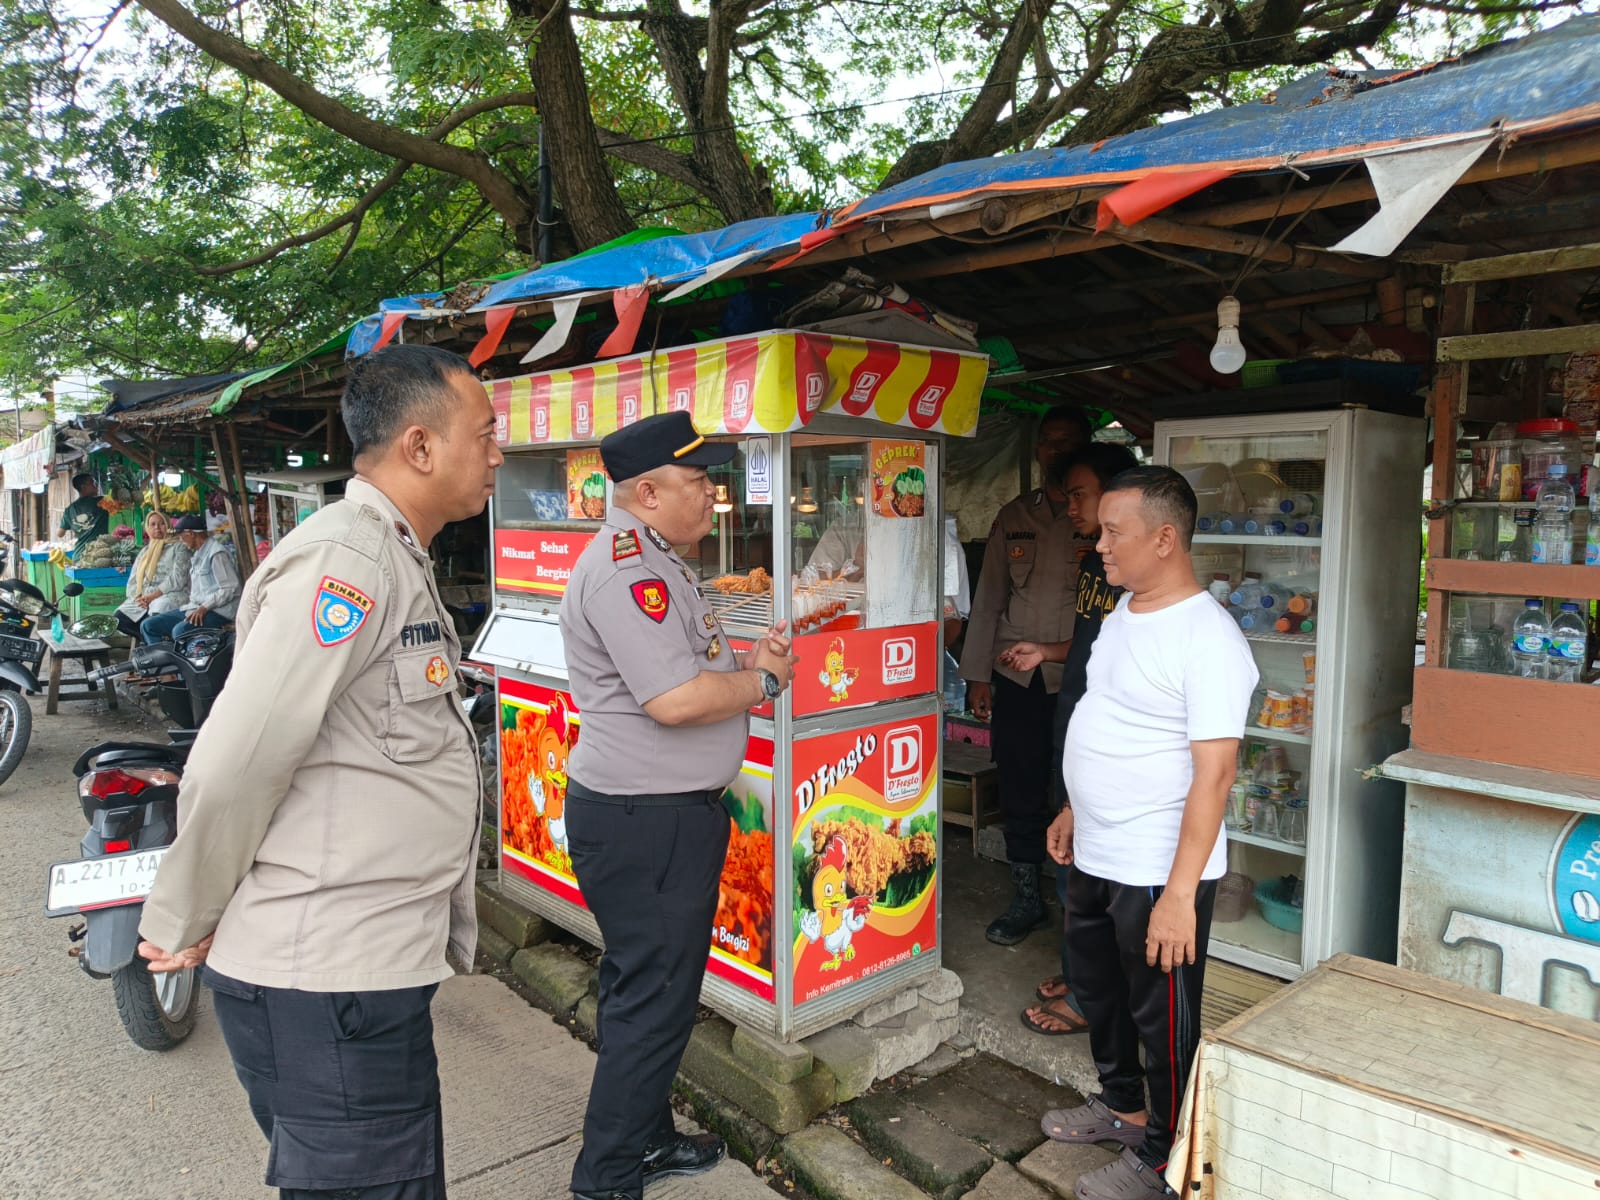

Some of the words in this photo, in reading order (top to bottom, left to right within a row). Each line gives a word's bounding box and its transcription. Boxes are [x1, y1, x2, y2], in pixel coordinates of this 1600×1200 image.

[734, 384, 748, 403] D
[809, 376, 823, 396] D
[577, 404, 588, 421] D
[625, 398, 636, 417] D
[875, 445, 917, 469] GEPREK
[501, 546, 536, 560] Nikmat
[540, 541, 569, 554] Sehat
[536, 565, 571, 581] Bergizi
[327, 581, 369, 607] BINMAS
[886, 642, 912, 667] D
[889, 735, 919, 774] D
[795, 733, 878, 815] D'Fresto
[887, 775, 920, 791] D'Fresto
[55, 868, 66, 886] A
[81, 859, 128, 881] 2217
[136, 852, 168, 873] XA
[1569, 838, 1600, 881] Pre
[719, 925, 750, 952] Bergizi
[806, 989, 820, 1001] Info
